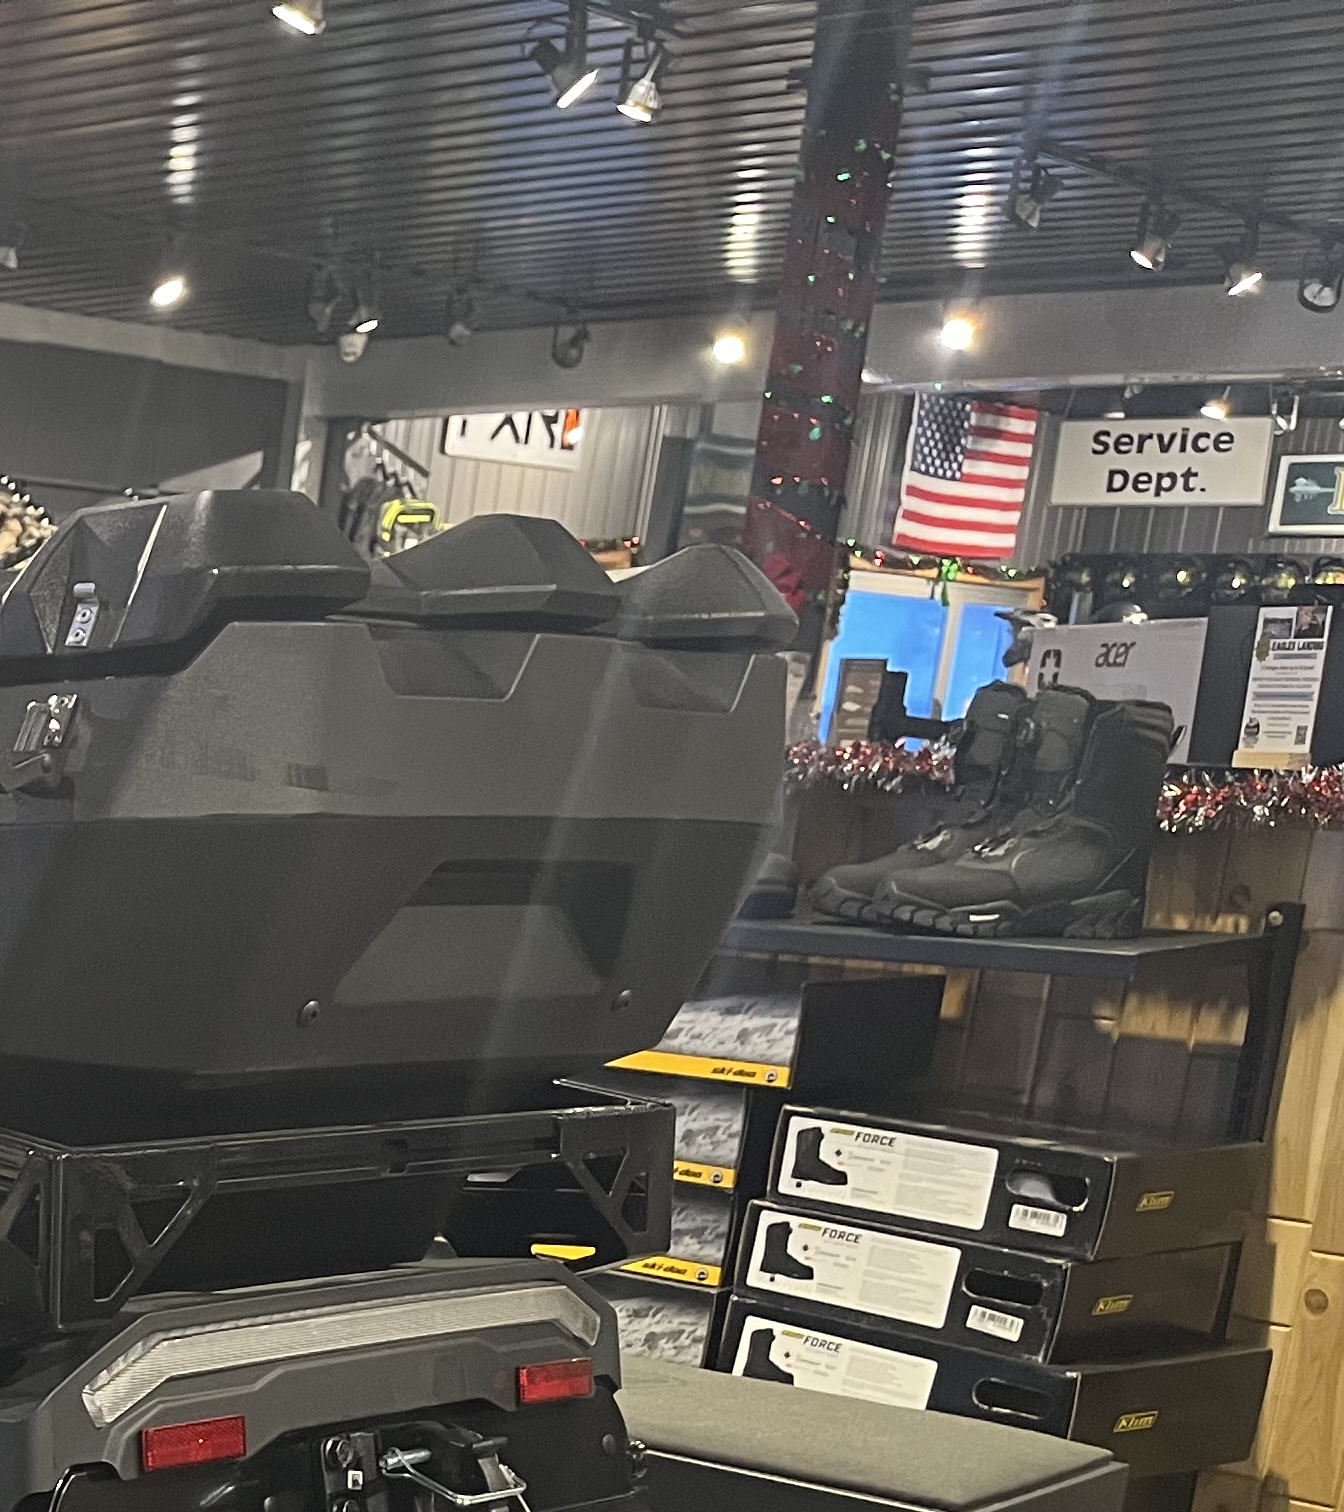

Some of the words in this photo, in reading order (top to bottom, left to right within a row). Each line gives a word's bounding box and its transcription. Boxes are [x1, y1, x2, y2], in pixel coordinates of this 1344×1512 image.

[1091, 426, 1235, 455] Service
[1106, 466, 1207, 498] Dept.
[1094, 641, 1137, 668] acer
[854, 1131, 898, 1148] FORCE
[821, 1227, 863, 1244] FORCE
[802, 1335, 843, 1354] FORCE
